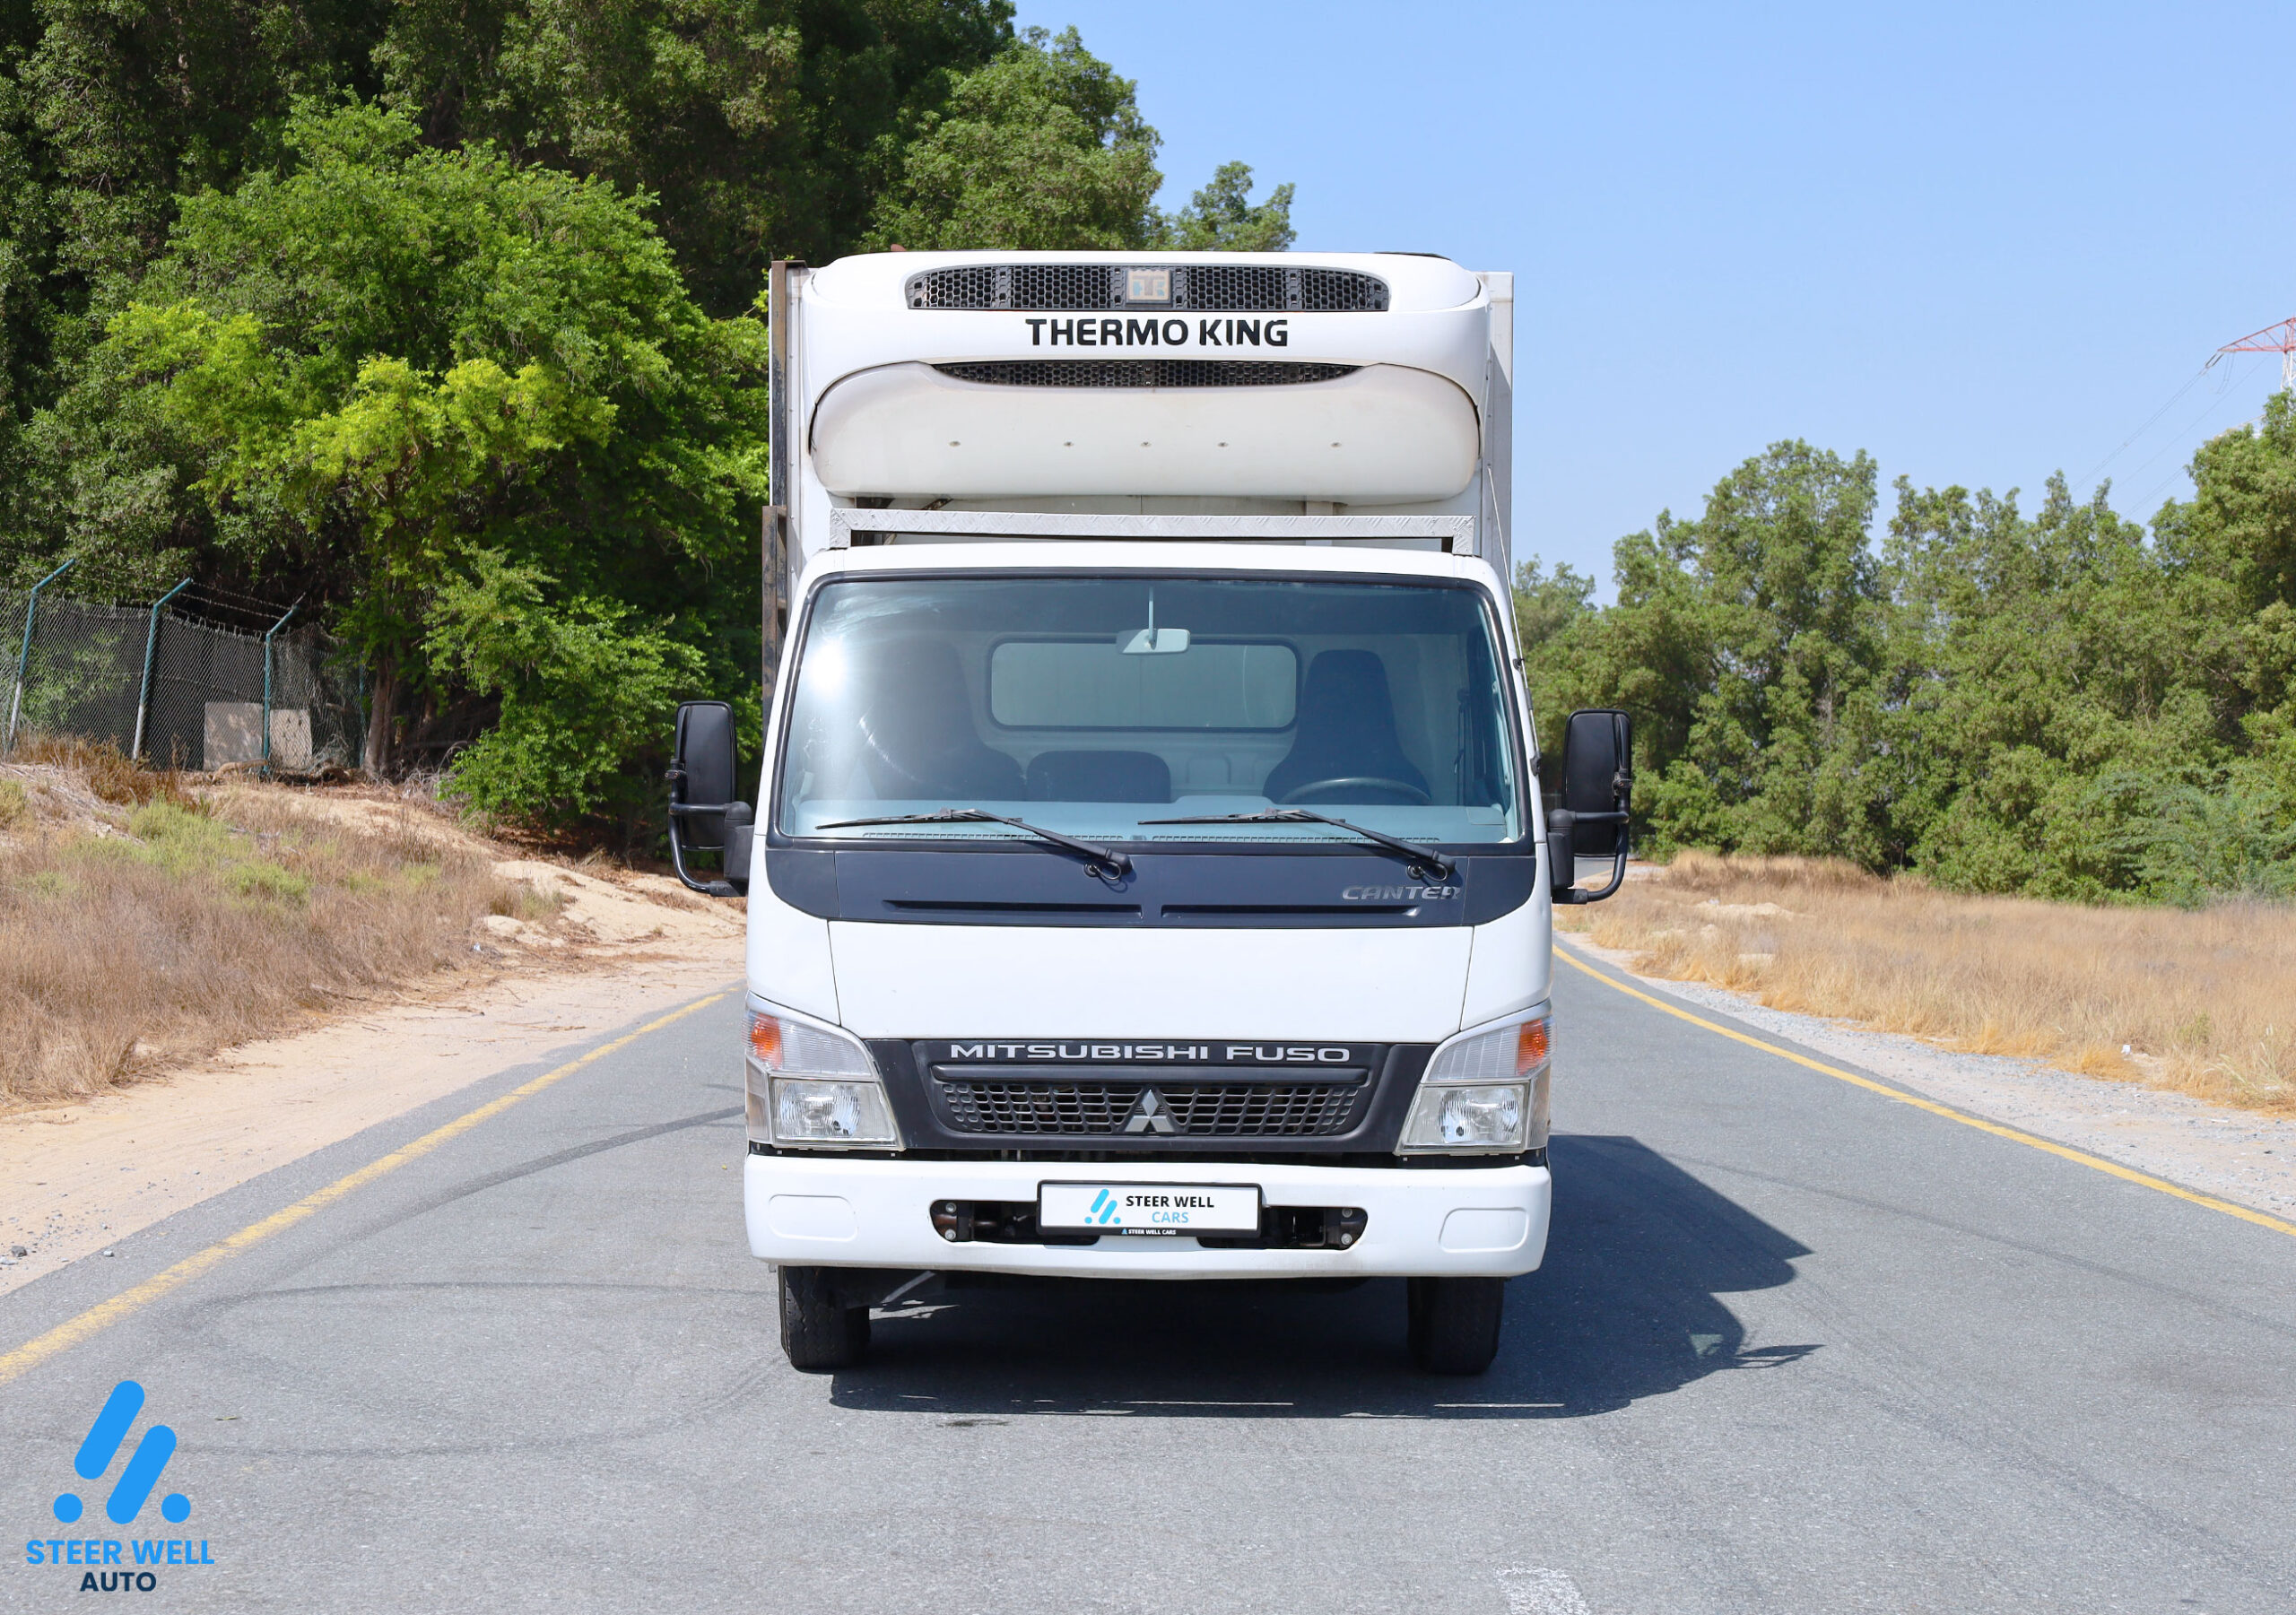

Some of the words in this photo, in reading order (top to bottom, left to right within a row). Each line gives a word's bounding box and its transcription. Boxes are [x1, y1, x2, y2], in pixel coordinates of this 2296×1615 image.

[1025, 318, 1188, 346] THERMO
[1199, 318, 1289, 346] KING
[1342, 885, 1461, 900] CANTER
[951, 1044, 1208, 1060] MITSUBISHI
[1226, 1046, 1351, 1063] FUSO
[1126, 1195, 1170, 1208] STEER
[1174, 1196, 1214, 1209] WELL
[1152, 1211, 1189, 1224] CARS
